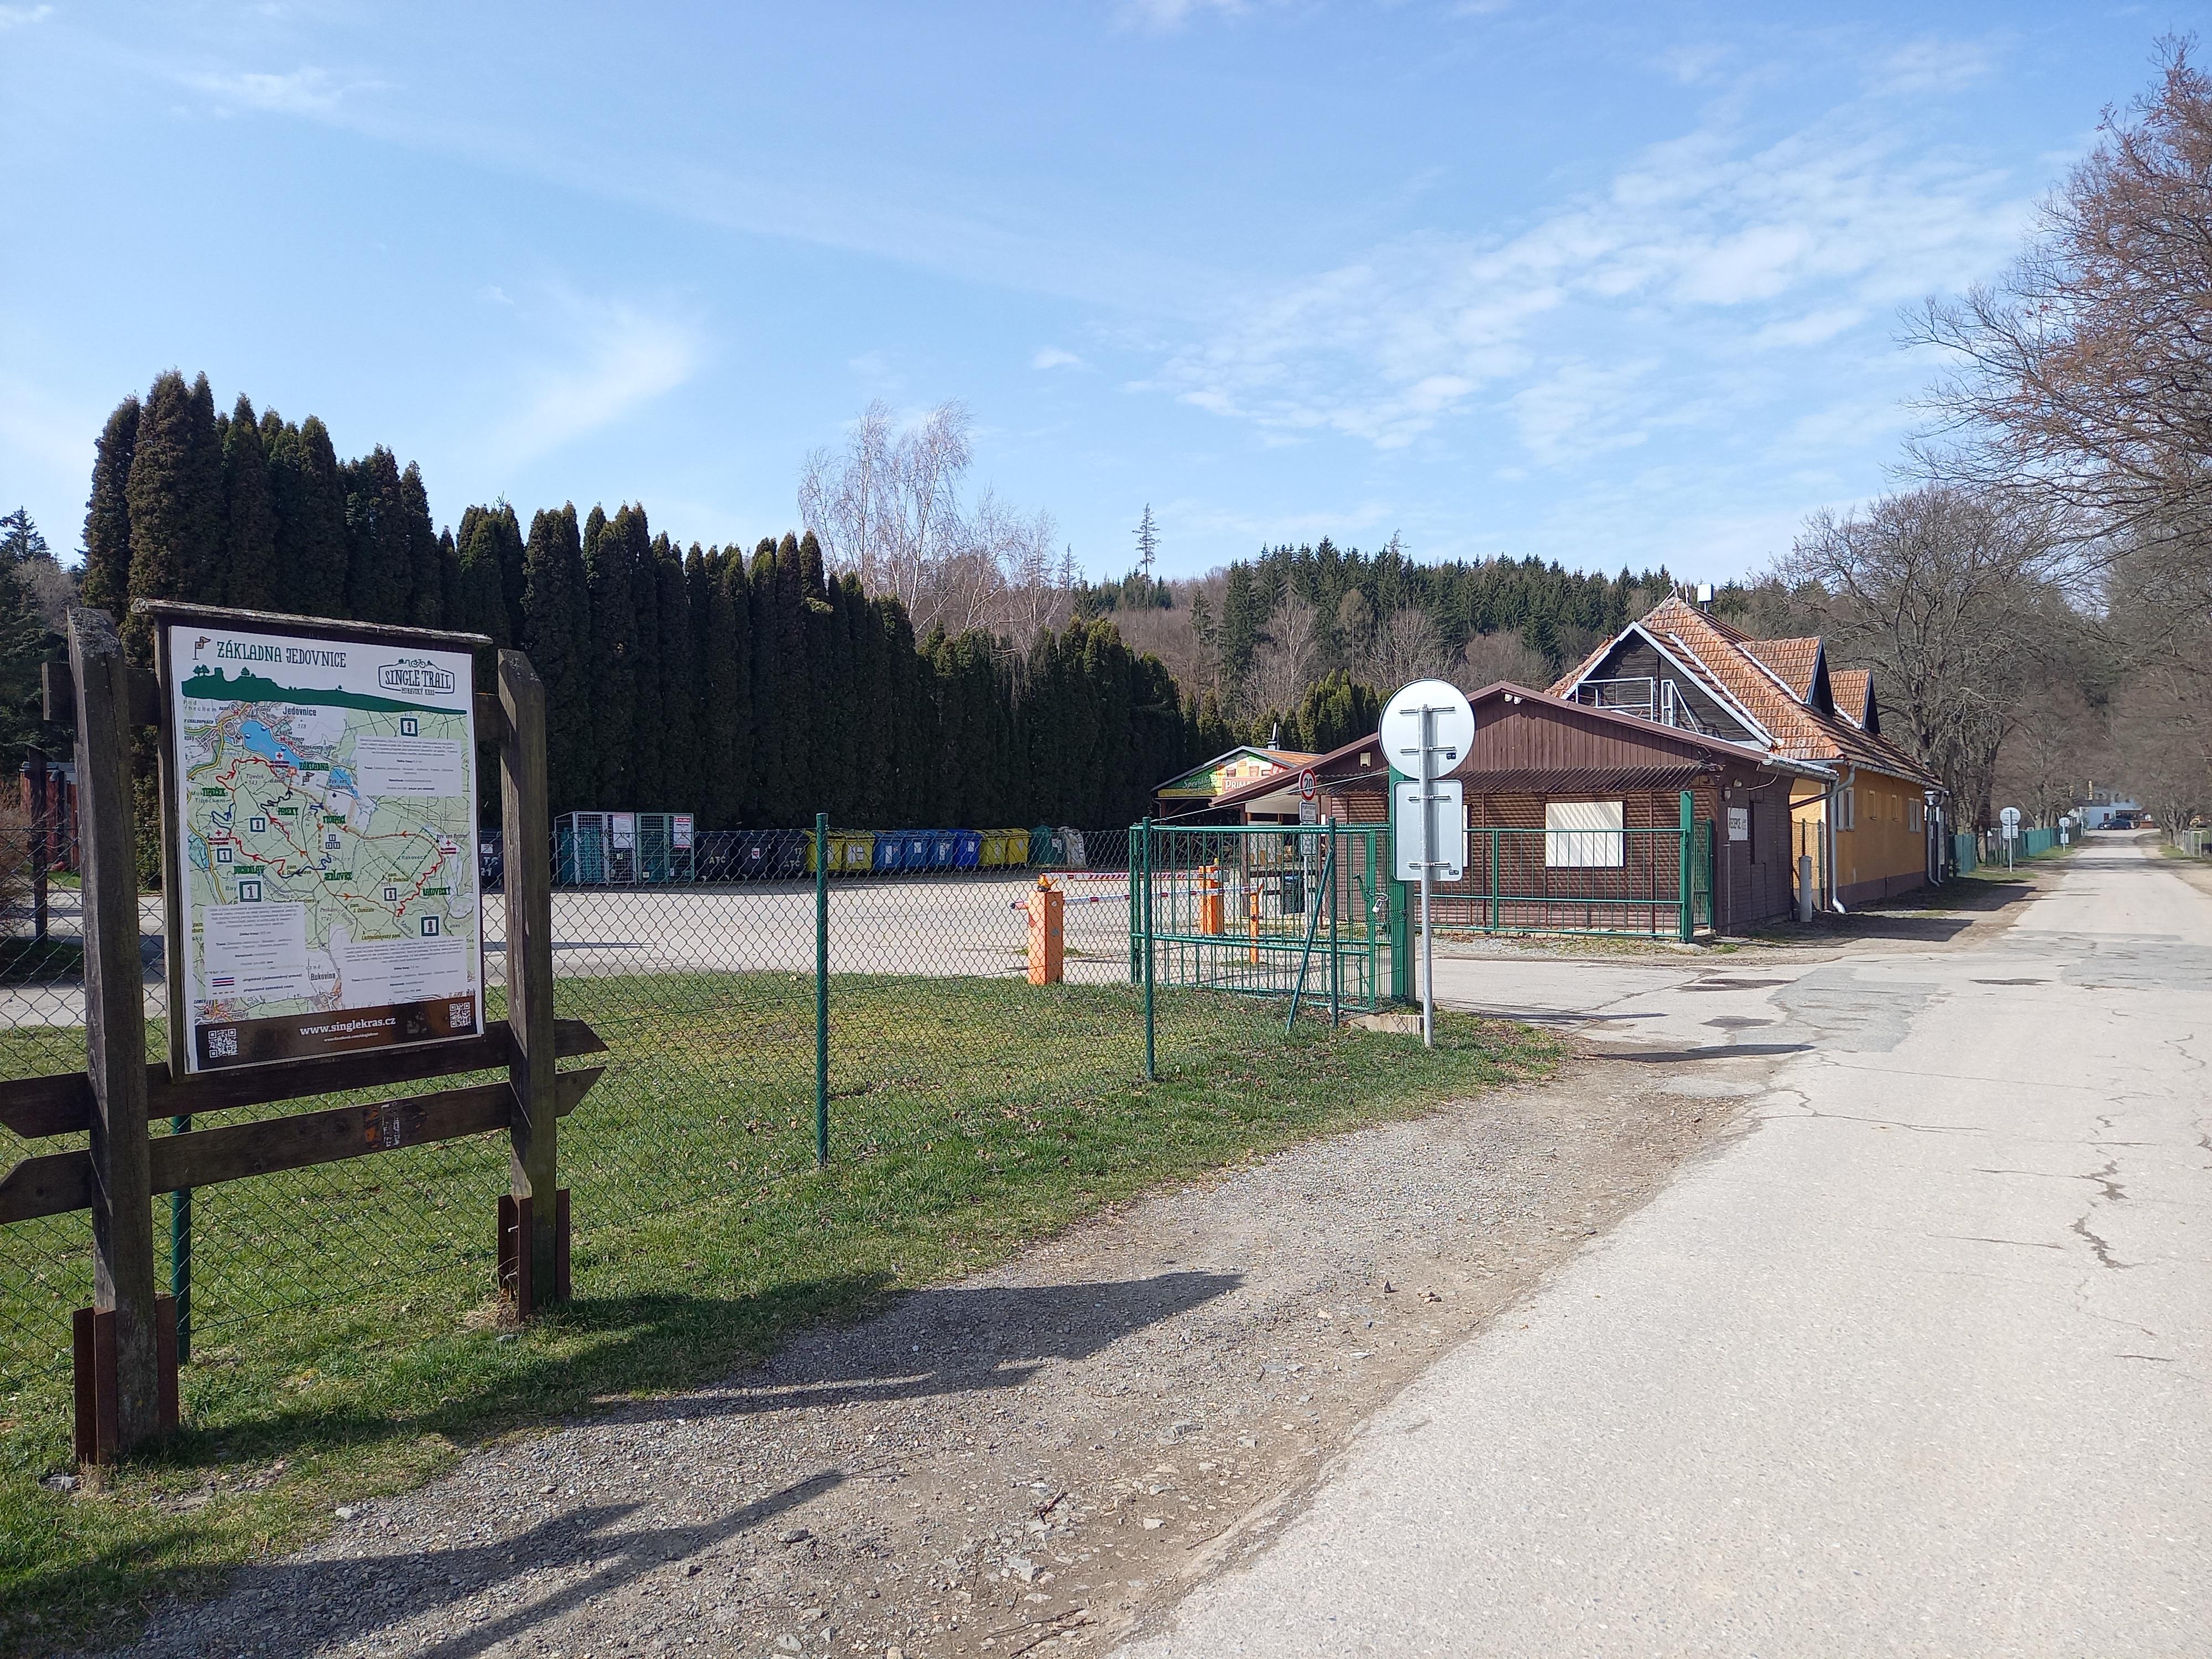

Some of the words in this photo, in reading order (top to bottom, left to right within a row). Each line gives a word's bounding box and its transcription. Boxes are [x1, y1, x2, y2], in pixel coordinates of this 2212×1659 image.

[217, 640, 282, 662] ZÁKLADNA
[286, 648, 346, 667] JEDOVNICE
[385, 670, 420, 686] SINGLE
[421, 670, 451, 688] TRAIL
[283, 706, 316, 716] Jedovnice
[1304, 778, 1313, 791] 20
[222, 851, 227, 860] 1
[709, 856, 726, 864] ATC
[247, 885, 253, 898] 1
[311, 972, 336, 980] Bukovina
[300, 1016, 396, 1036] www.singlekras.cz
